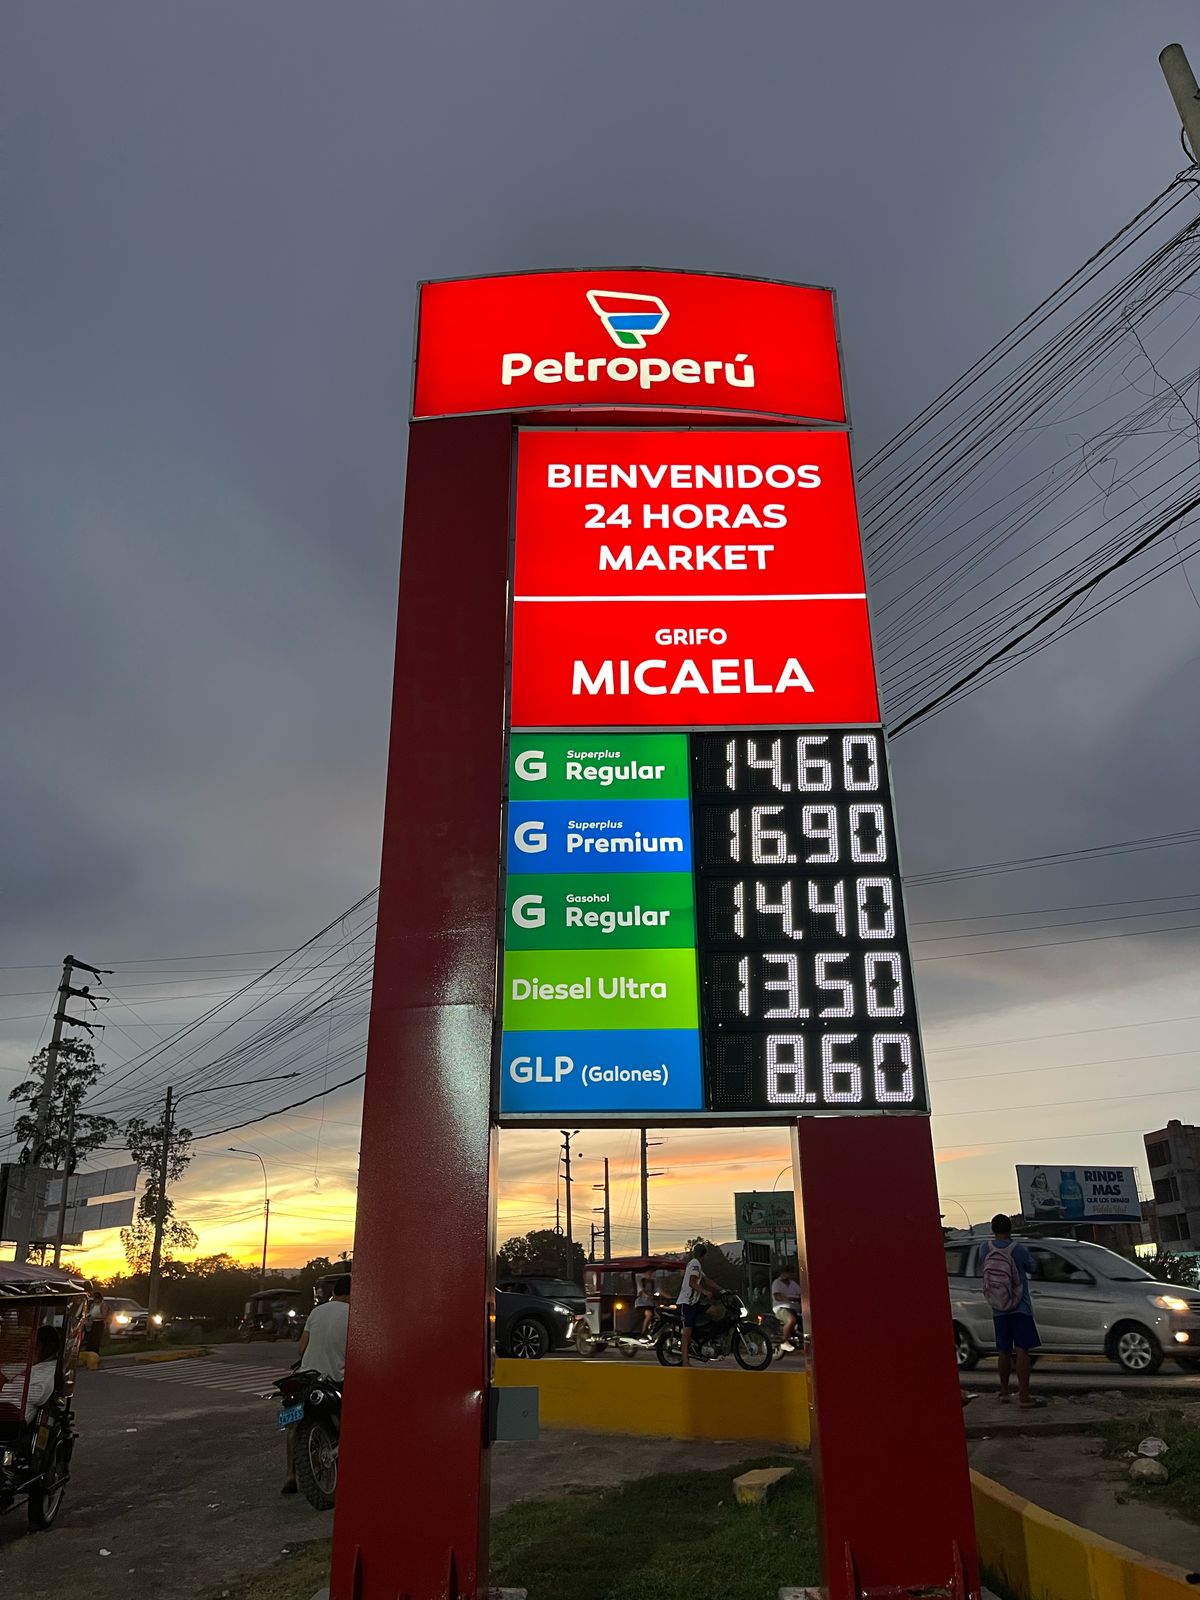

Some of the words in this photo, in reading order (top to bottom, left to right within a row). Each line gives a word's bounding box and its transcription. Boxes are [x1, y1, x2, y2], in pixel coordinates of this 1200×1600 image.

[501, 351, 755, 390] Petroperú
[547, 464, 822, 489] BIENVENIDOS
[584, 503, 632, 529] 24
[643, 503, 788, 529] HORAS
[598, 544, 775, 571] MARKET
[655, 627, 728, 646] GRIFO
[571, 657, 815, 696] MICAELA
[514, 750, 547, 782] G
[566, 749, 621, 760] Superplus
[726, 735, 880, 793] 14.60
[566, 761, 666, 786] Regular
[514, 821, 547, 854] G
[567, 820, 623, 831] Superplus
[729, 803, 888, 865] 16.90
[566, 831, 684, 854] Premium
[511, 894, 546, 929] G
[566, 893, 610, 903] Gasohol
[733, 877, 896, 940] 14.40
[566, 906, 671, 934] Regular
[512, 976, 591, 1001] Diesel
[598, 976, 667, 1000] Ultra
[738, 952, 905, 1019] 13.50
[509, 1055, 574, 1084] GLP
[581, 1063, 669, 1086] (Galones)
[766, 1033, 915, 1104] 8.60
[1084, 1170, 1124, 1182] RINDE
